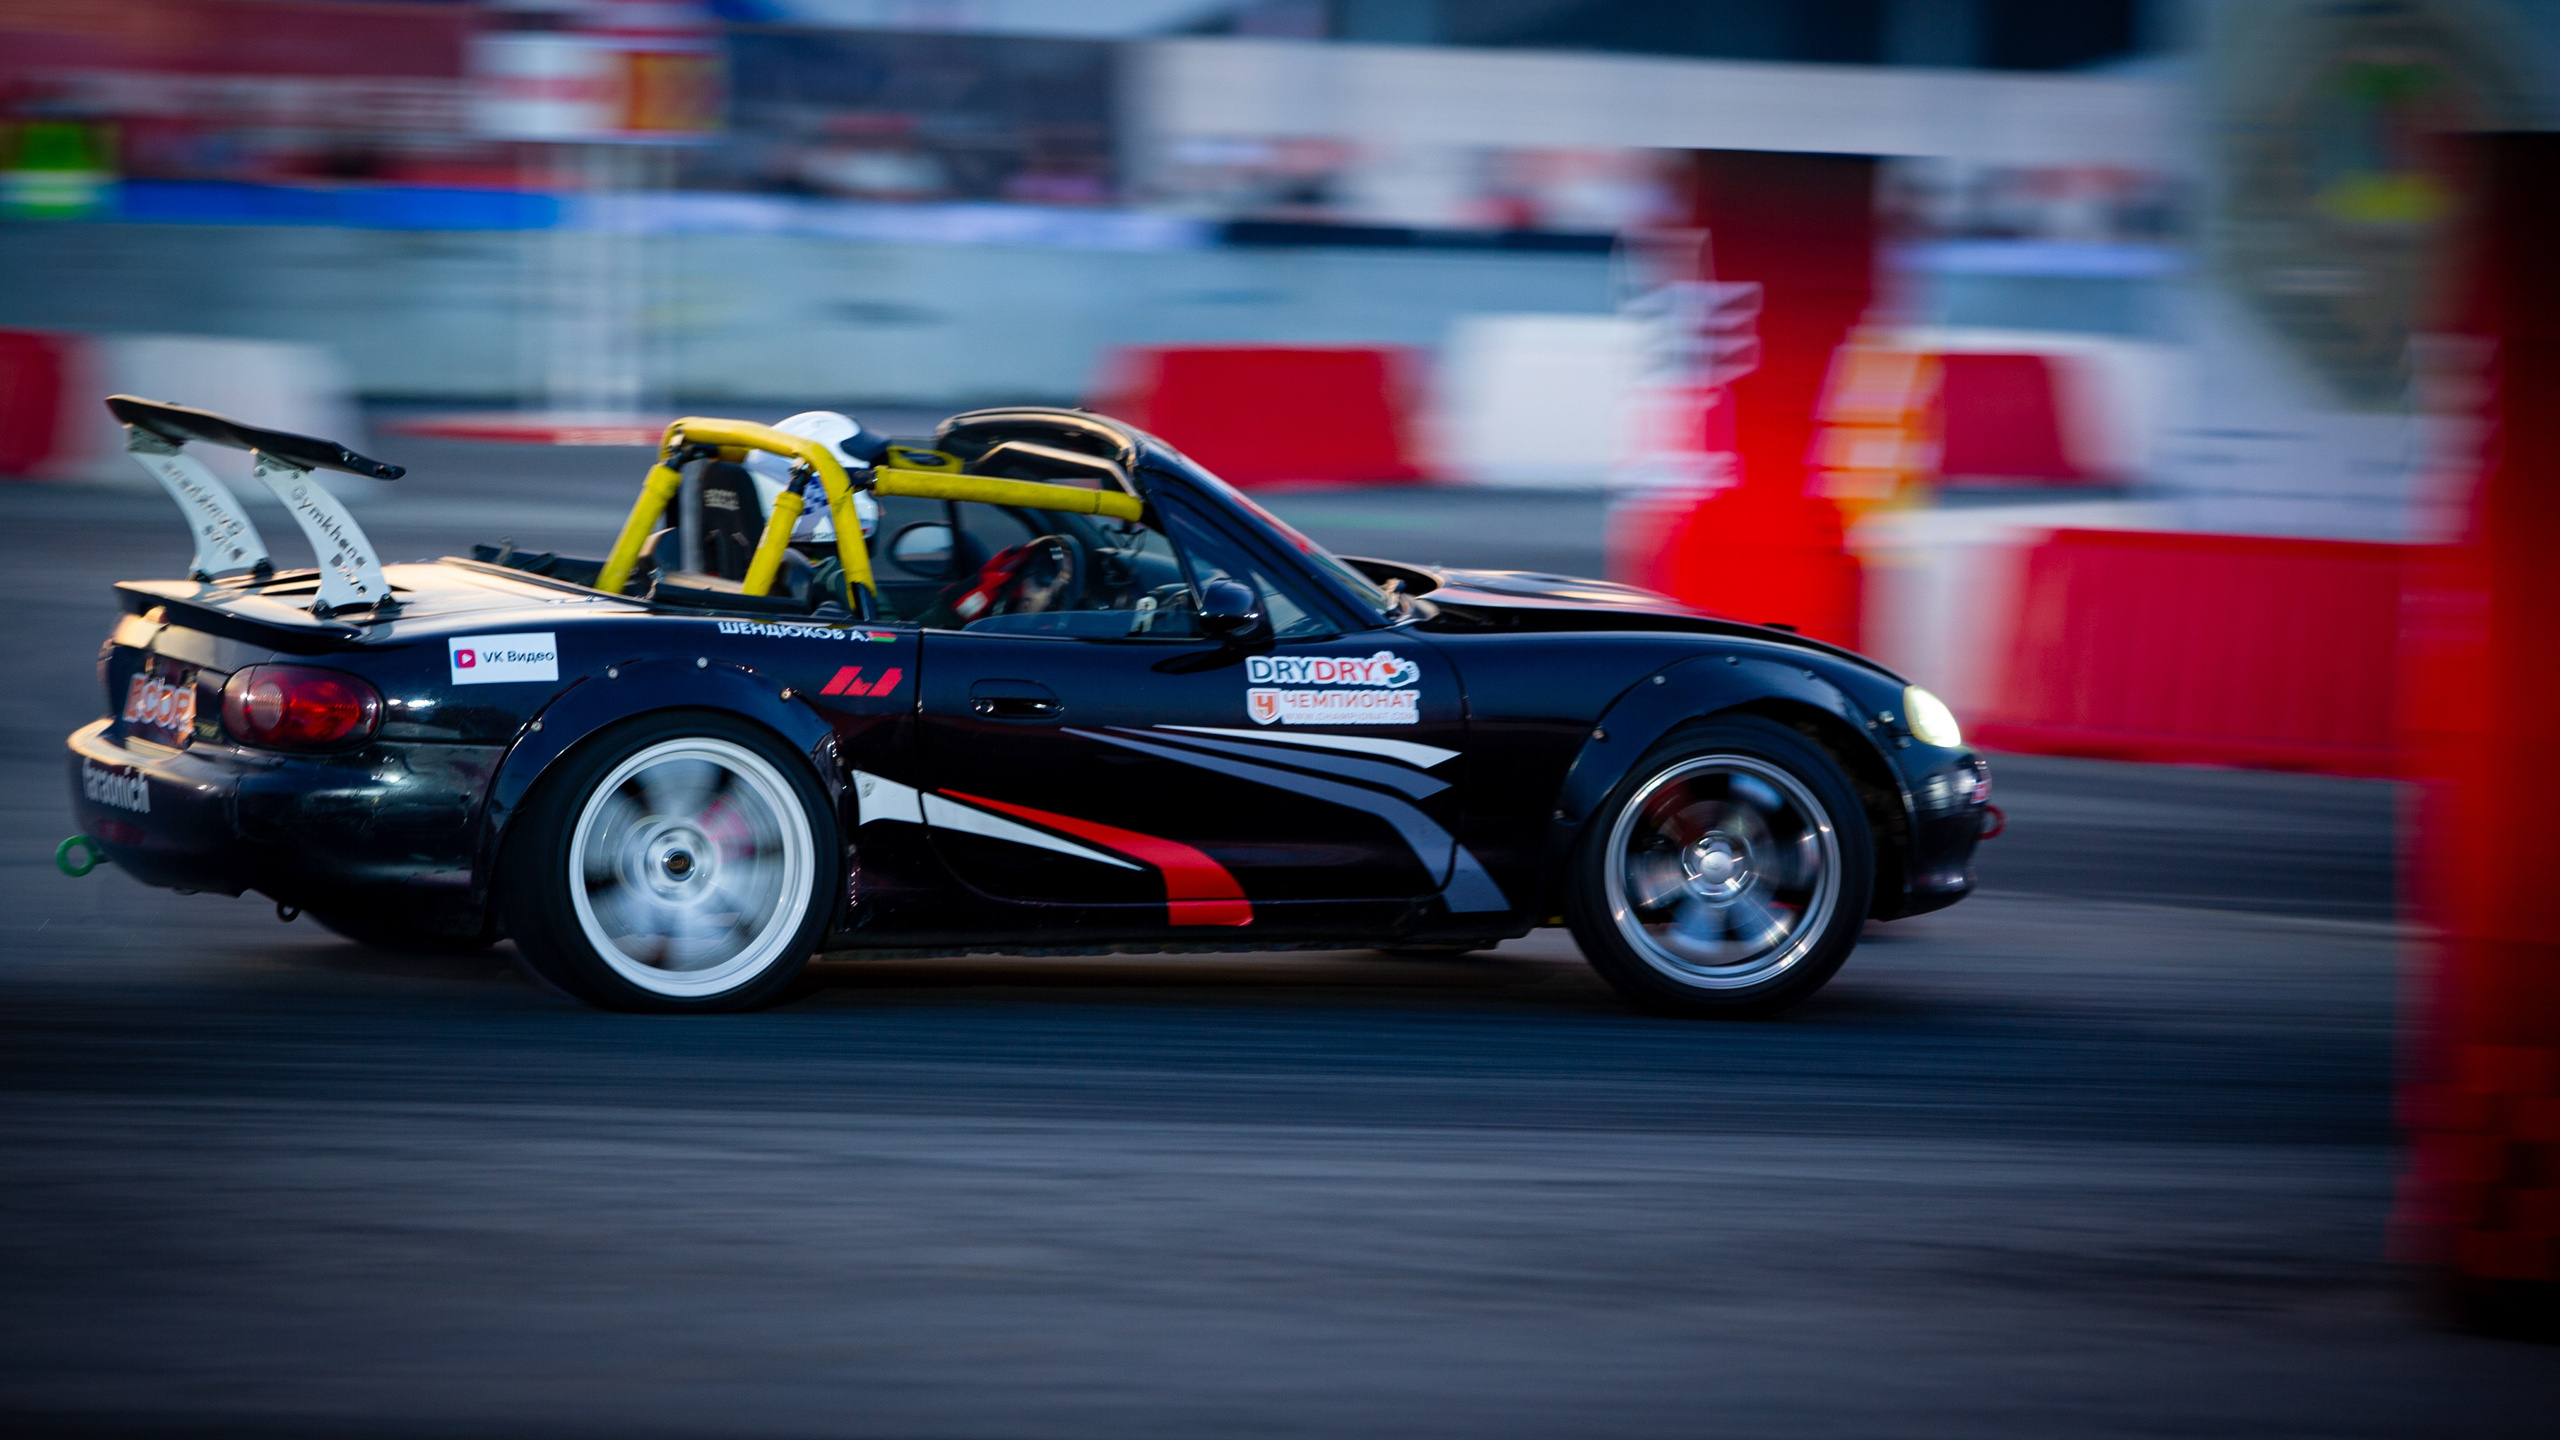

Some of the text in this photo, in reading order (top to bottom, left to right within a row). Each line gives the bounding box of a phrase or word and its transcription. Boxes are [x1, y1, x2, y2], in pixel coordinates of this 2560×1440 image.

[291, 486, 367, 568] Gymkhana
[329, 552, 368, 596] Drive
[717, 621, 846, 640] ШЕНДЮКОВ
[482, 650, 555, 663] VK Видео
[1283, 692, 1416, 709] ЧЕМПИОНАТ
